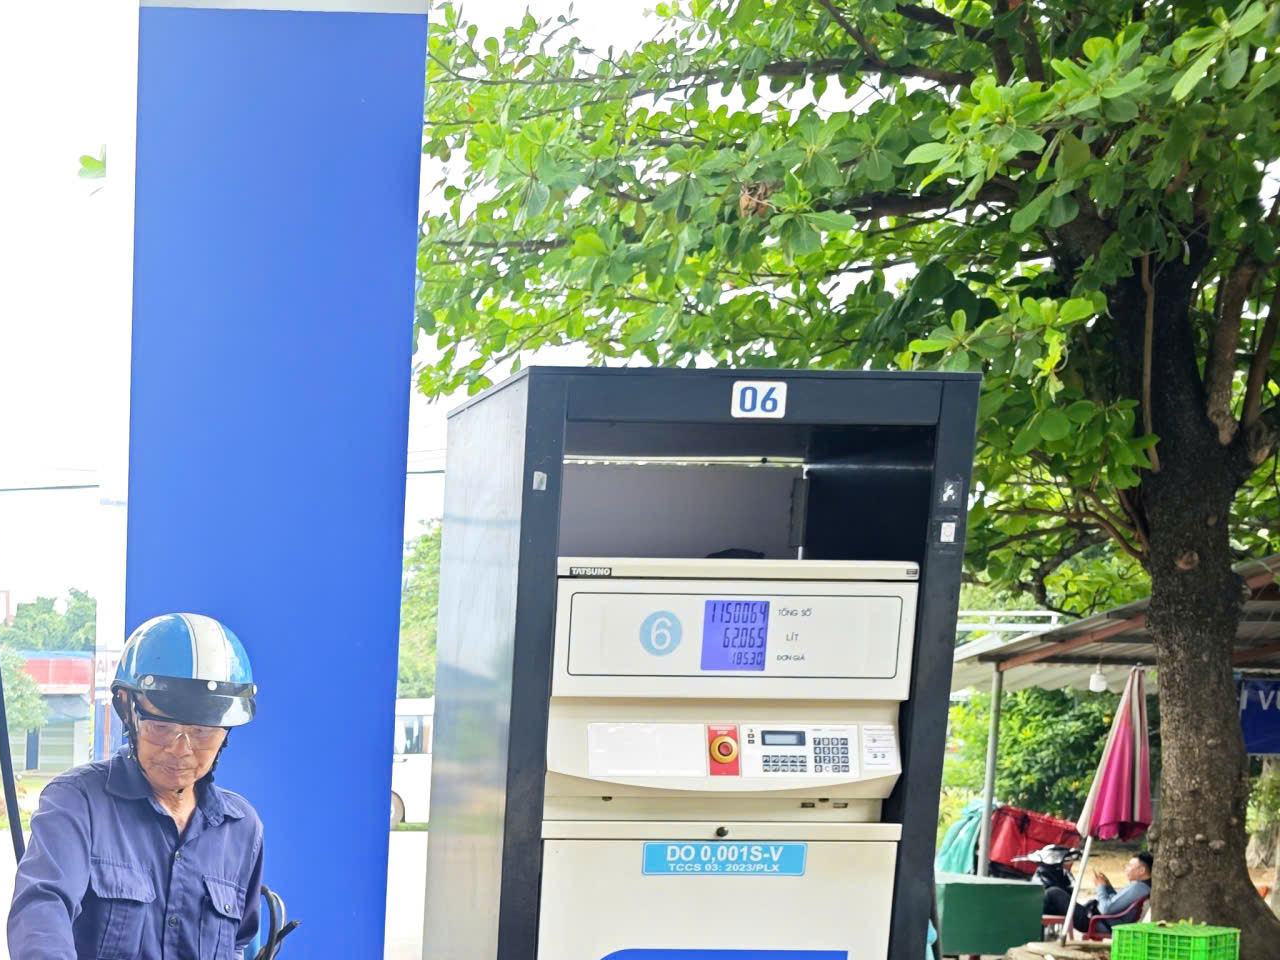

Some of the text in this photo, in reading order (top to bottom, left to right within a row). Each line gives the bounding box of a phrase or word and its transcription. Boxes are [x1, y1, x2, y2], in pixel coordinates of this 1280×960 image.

[739, 386, 778, 413] 06
[571, 567, 612, 576] TATSUNO
[711, 602, 768, 623] 1150064
[650, 616, 672, 650] 6
[785, 631, 799, 641] LÍT
[732, 651, 763, 666] 18530
[666, 845, 784, 863] DO 0,001S-V
[668, 863, 780, 872] TCCS 03: 2023/PLX
